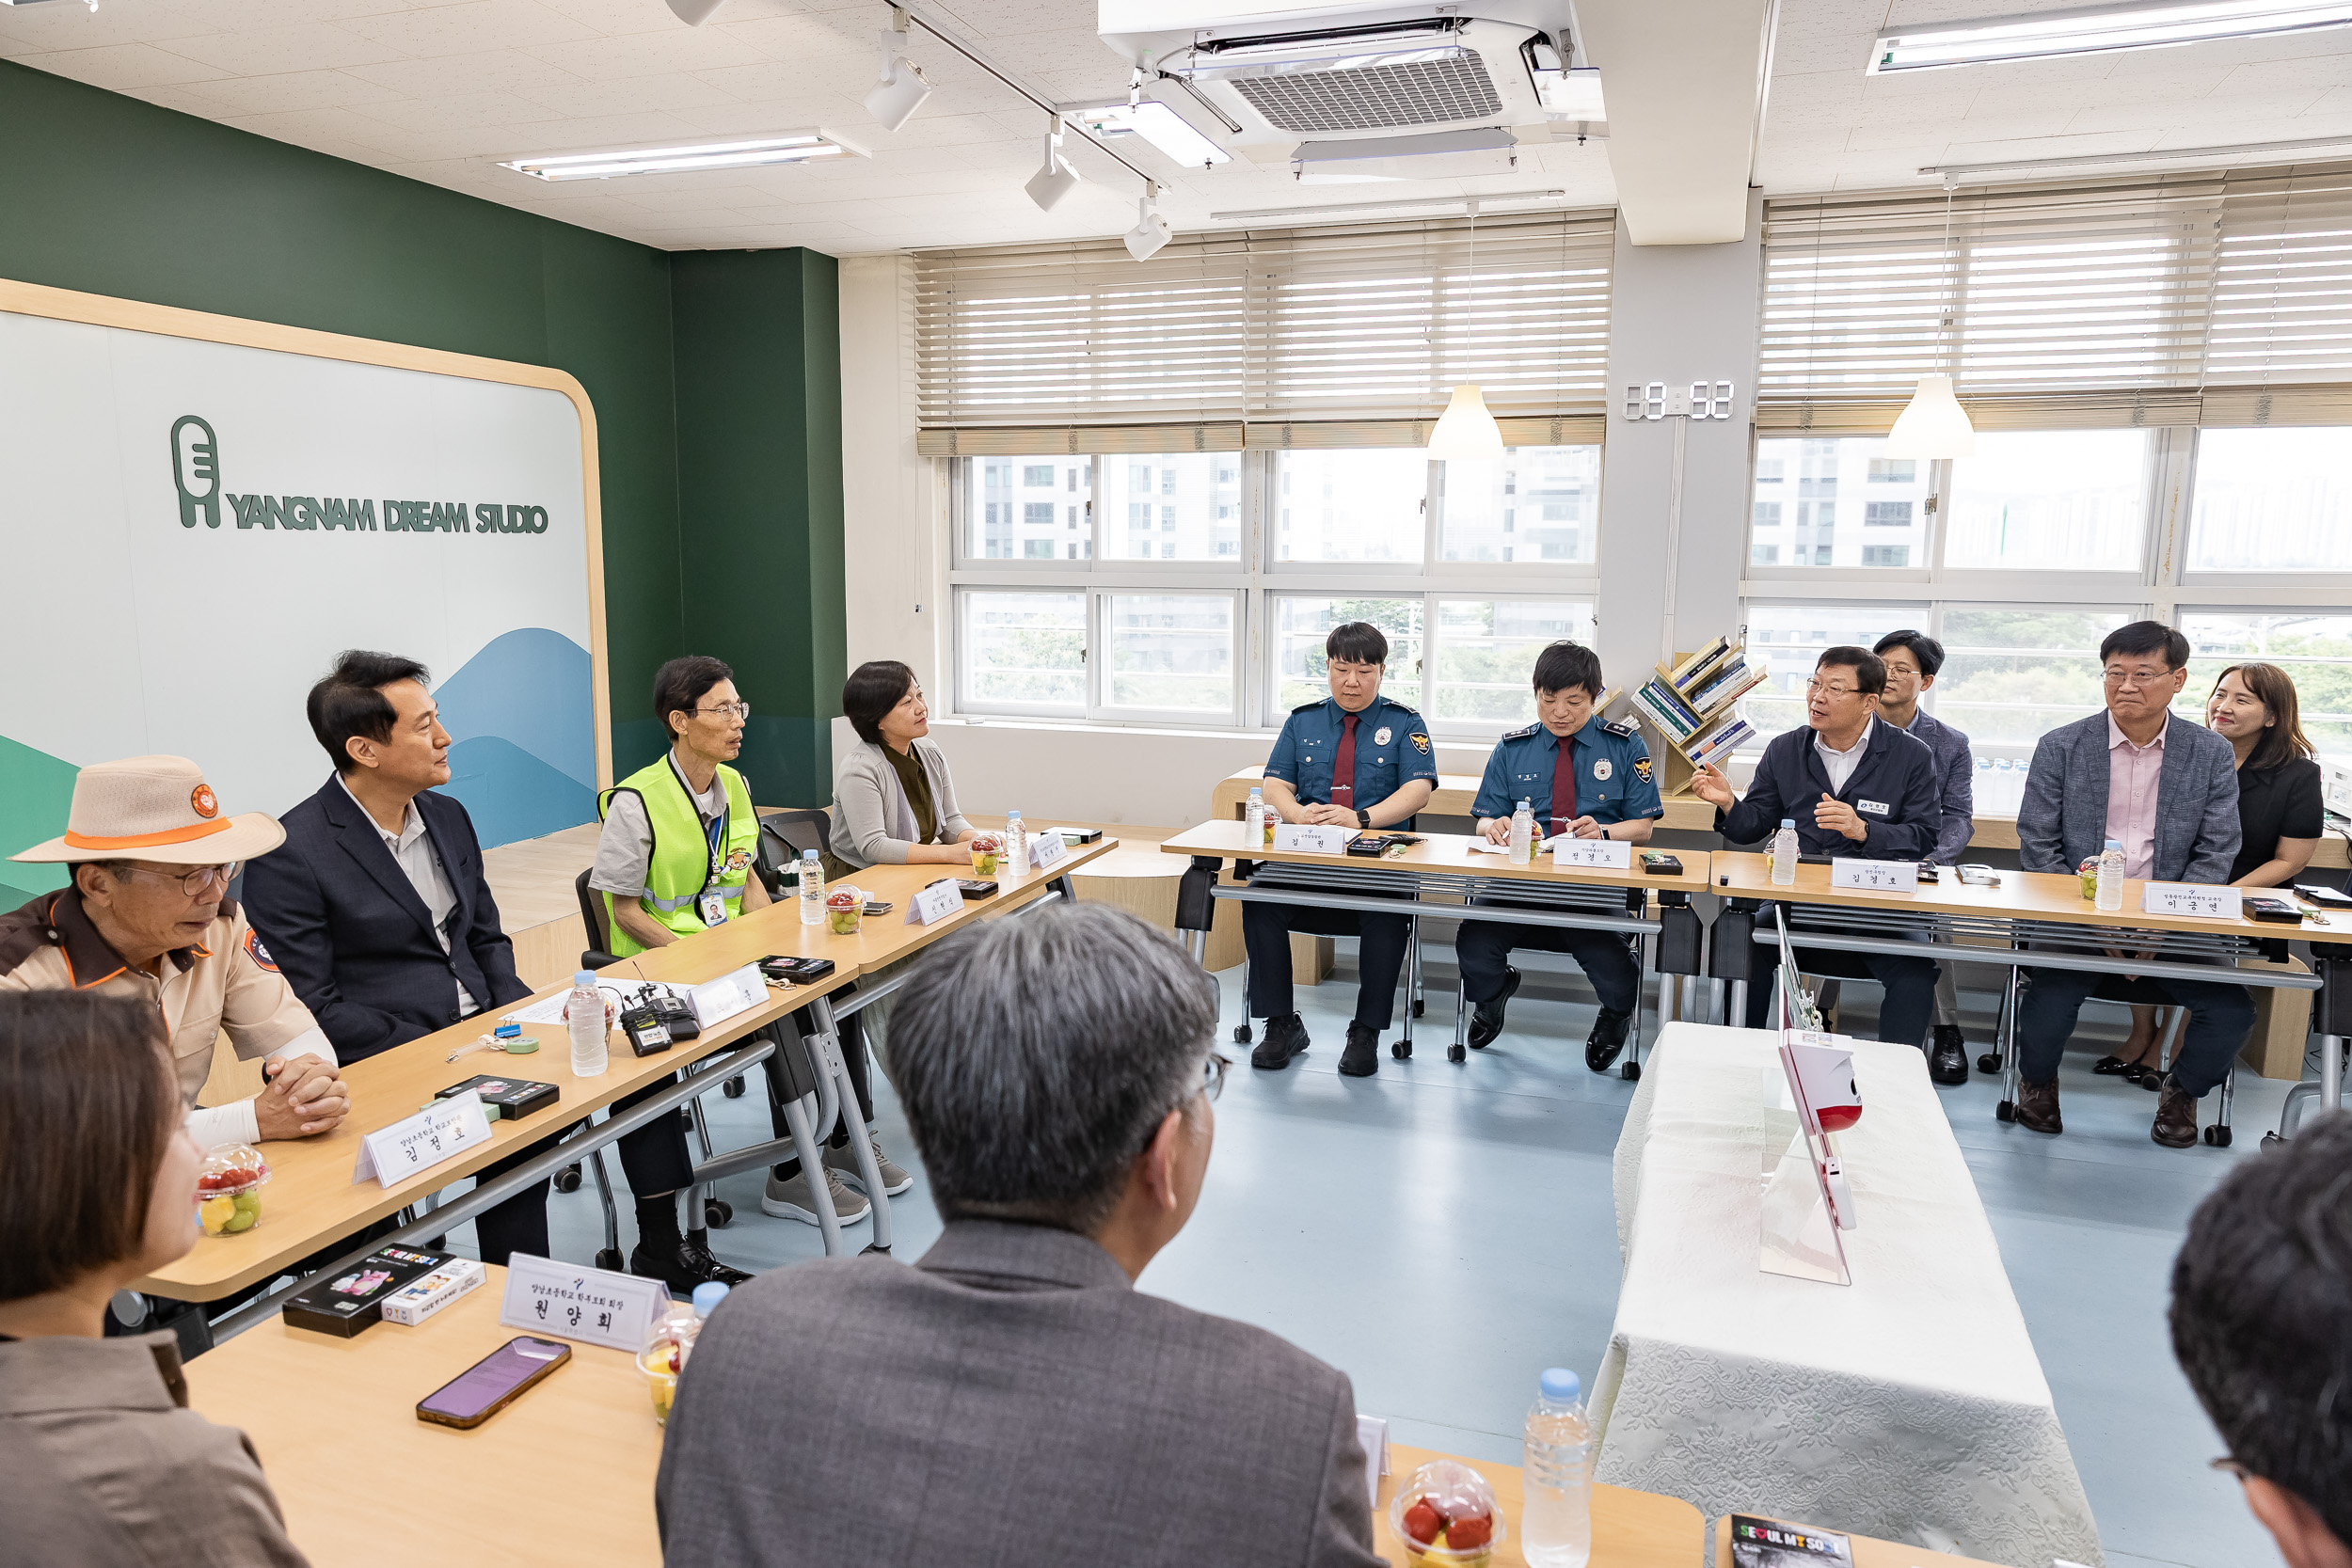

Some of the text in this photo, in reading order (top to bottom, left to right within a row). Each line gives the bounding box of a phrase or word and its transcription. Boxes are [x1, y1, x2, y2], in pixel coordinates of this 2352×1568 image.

[226, 494, 548, 534] YANGNAM DREAM STUDIO
[532, 1283, 624, 1311] 양남초등학교 학부모회 회장
[1740, 1524, 1784, 1544] SEOUL
[1805, 1537, 1842, 1555] SOUL
